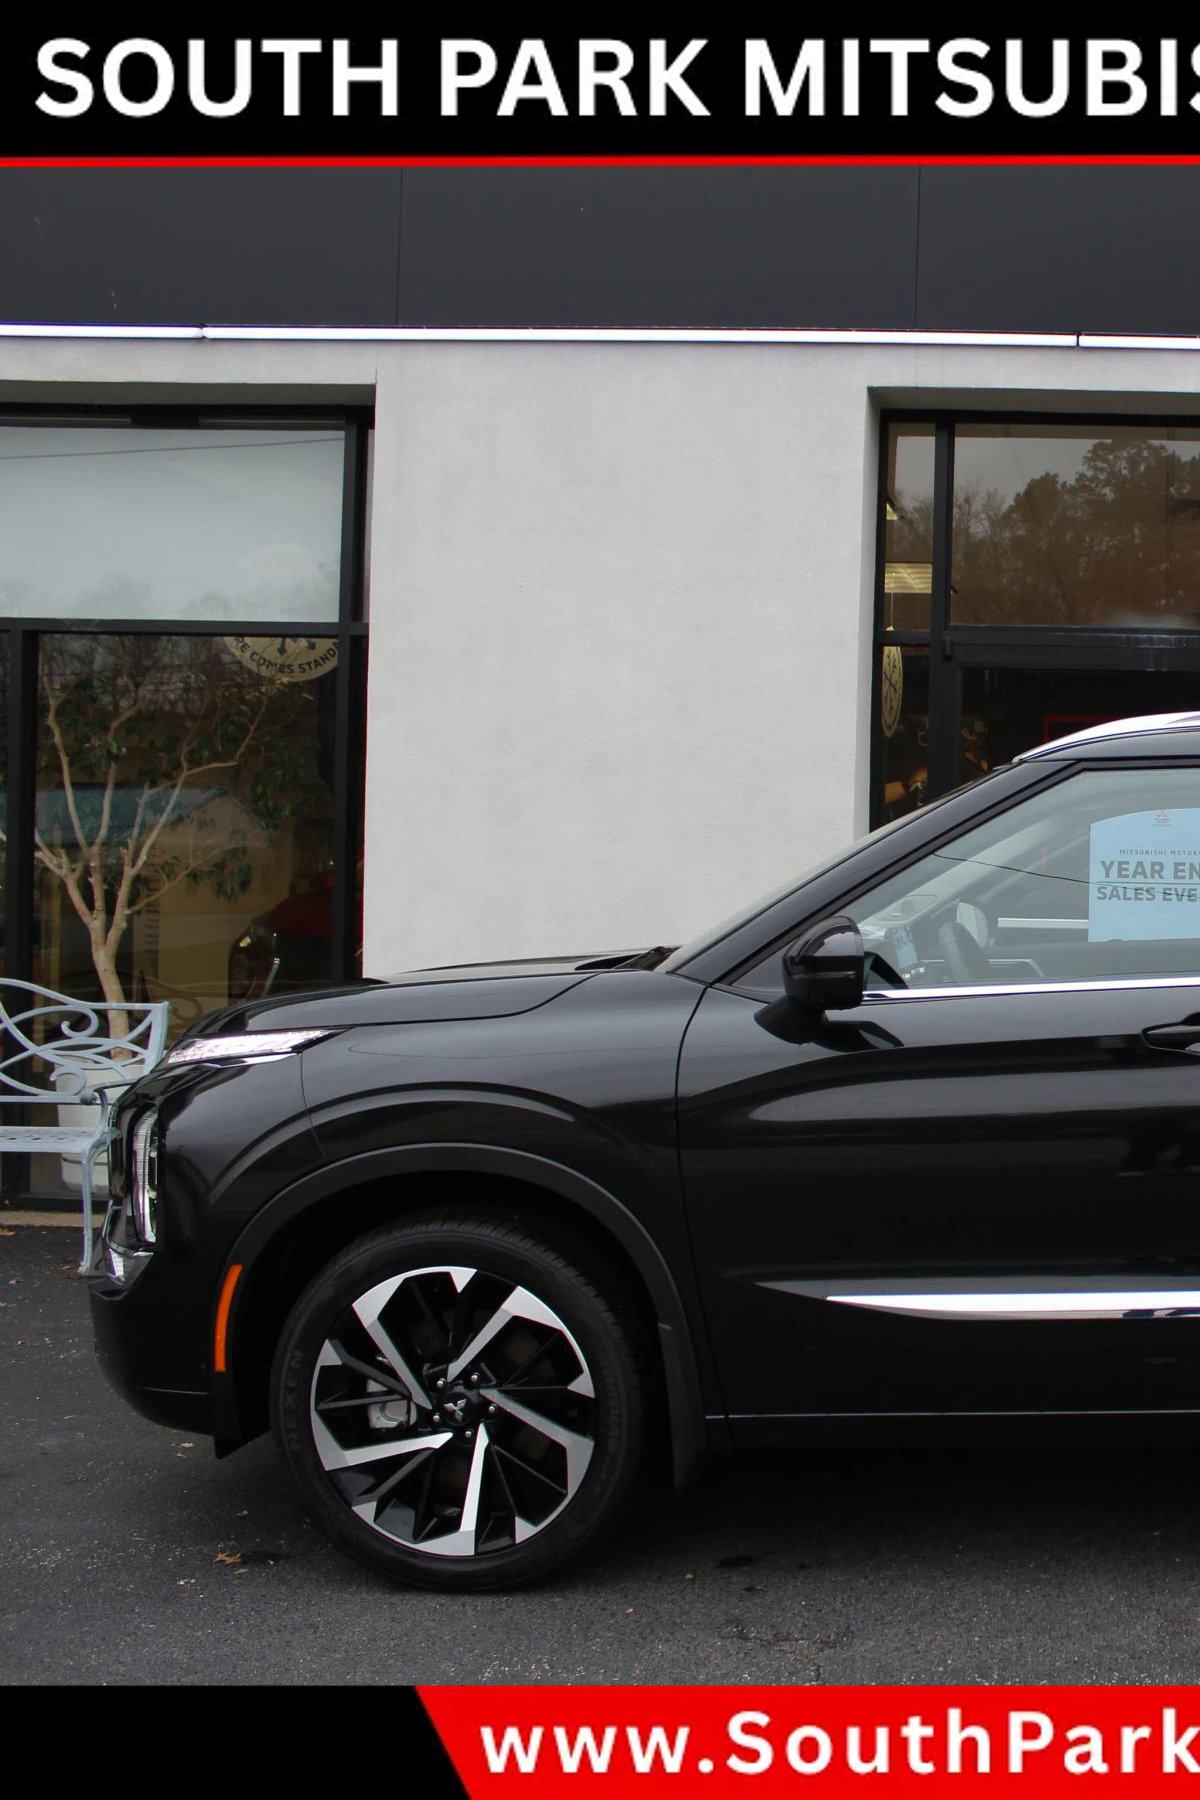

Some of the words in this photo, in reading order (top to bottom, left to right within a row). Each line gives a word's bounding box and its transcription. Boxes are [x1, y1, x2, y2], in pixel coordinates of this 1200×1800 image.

[249, 651, 294, 674] COMES
[1100, 860, 1165, 880] YEAR
[1096, 885, 1156, 901] SALES
[285, 1348, 304, 1452] NEXEN
